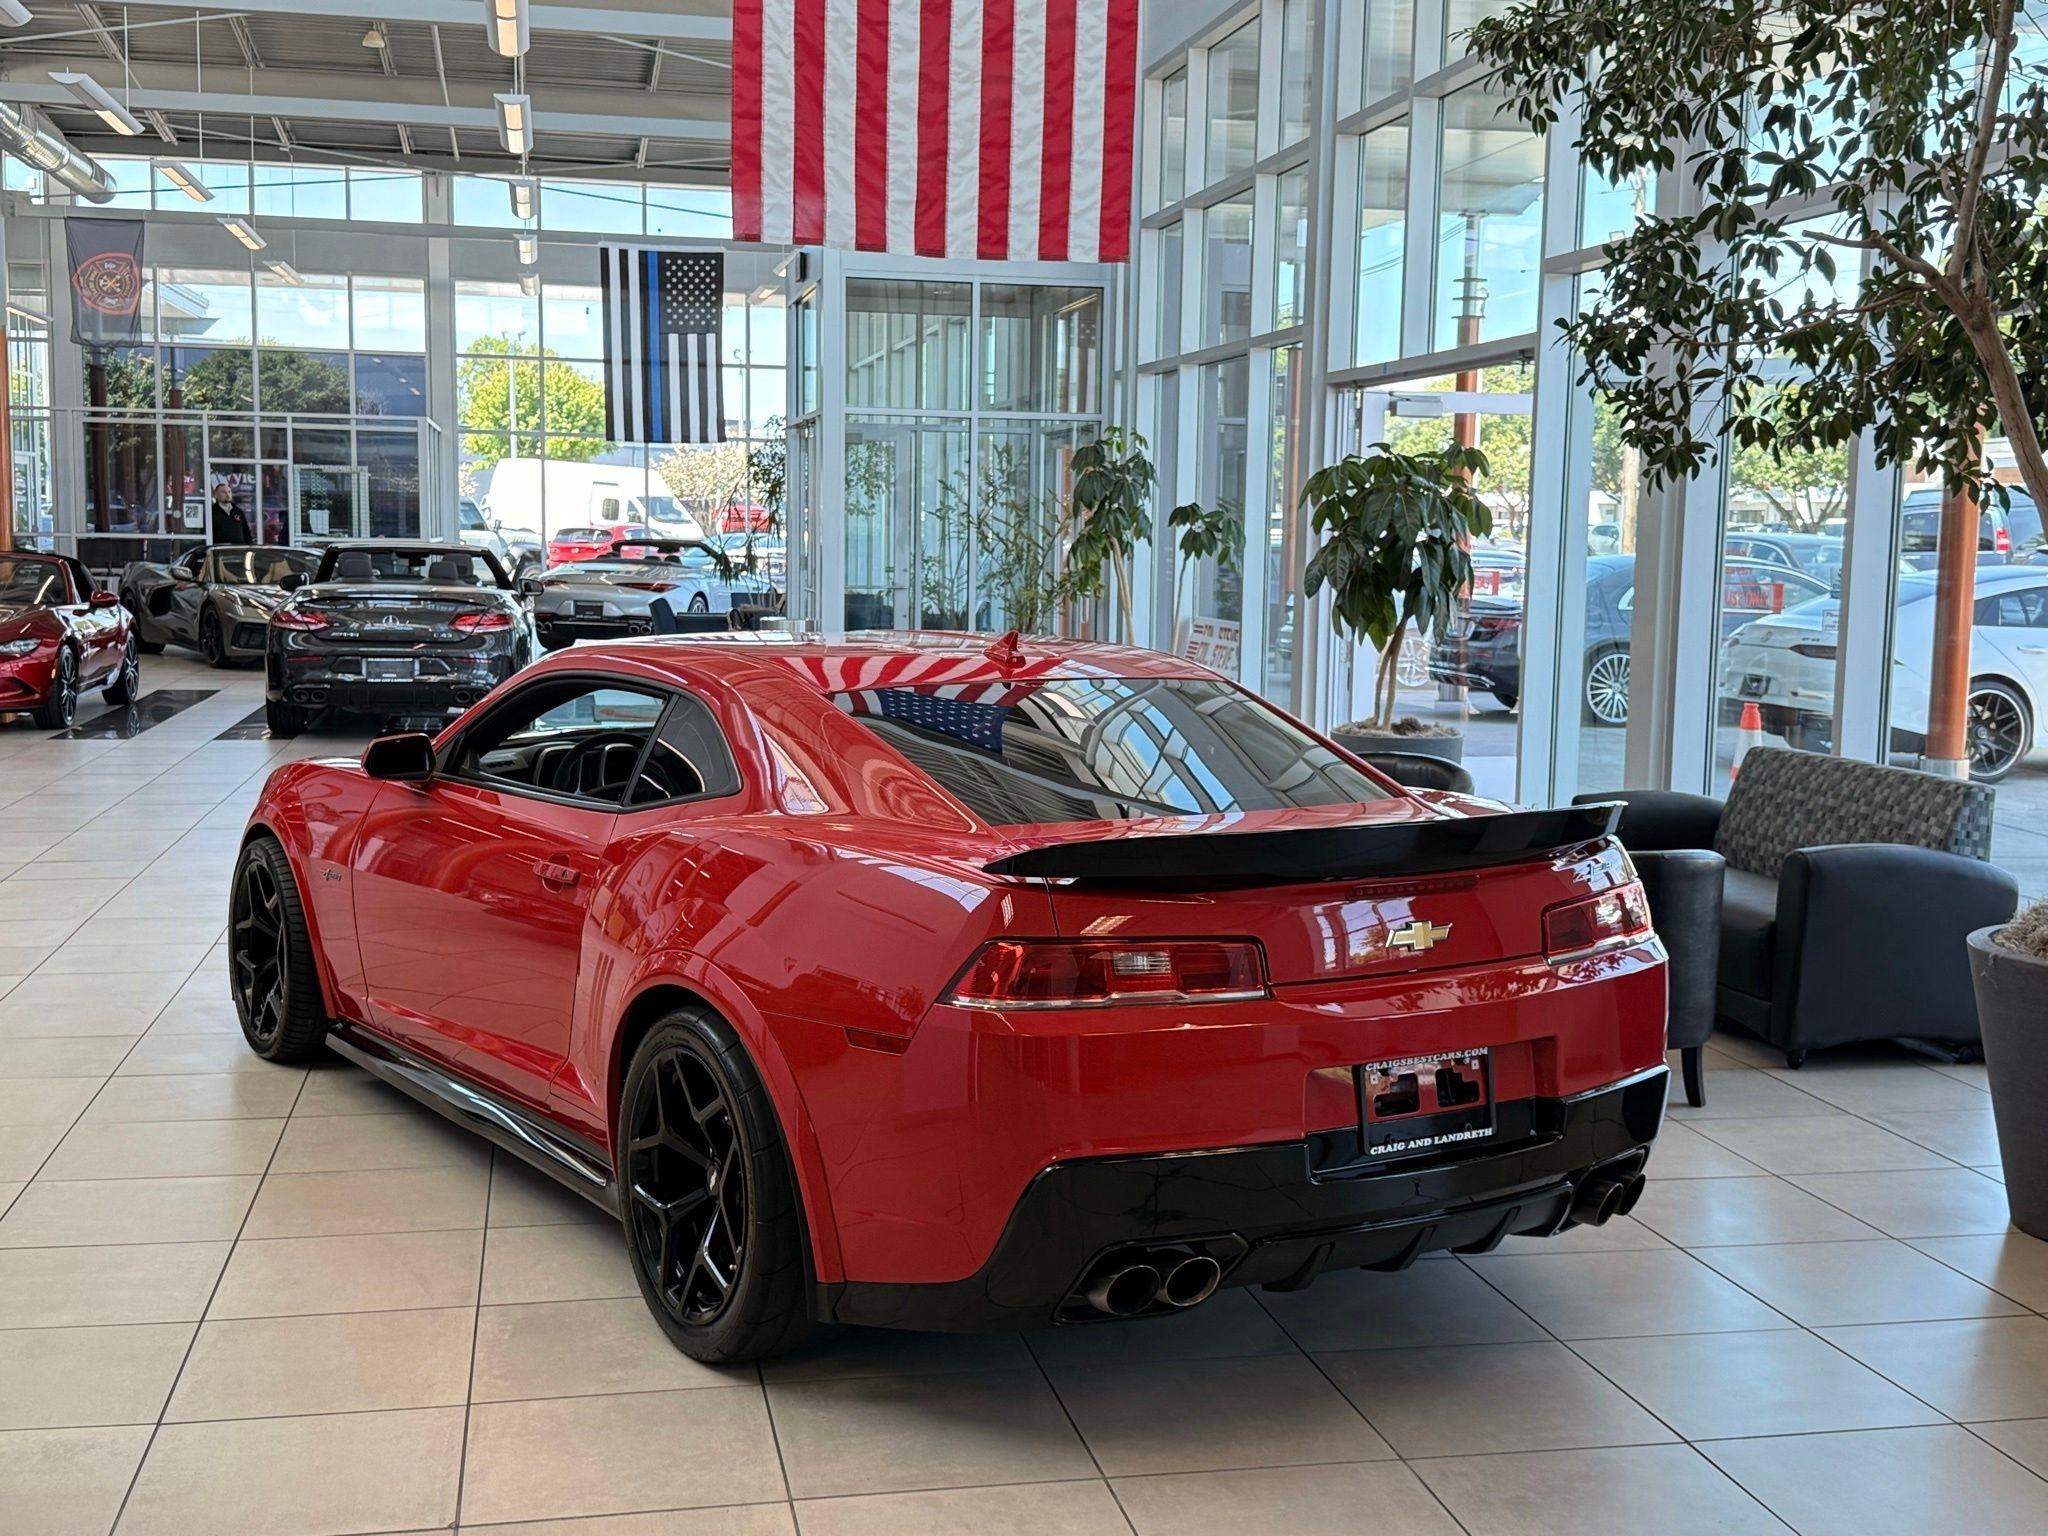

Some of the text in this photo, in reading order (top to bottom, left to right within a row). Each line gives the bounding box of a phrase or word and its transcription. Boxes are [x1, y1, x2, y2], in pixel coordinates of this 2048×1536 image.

[1365, 1046, 1488, 1071] CRAIGSBESTCARS.COM
[1370, 1127, 1493, 1156] CRAIG AND LANDRETH
